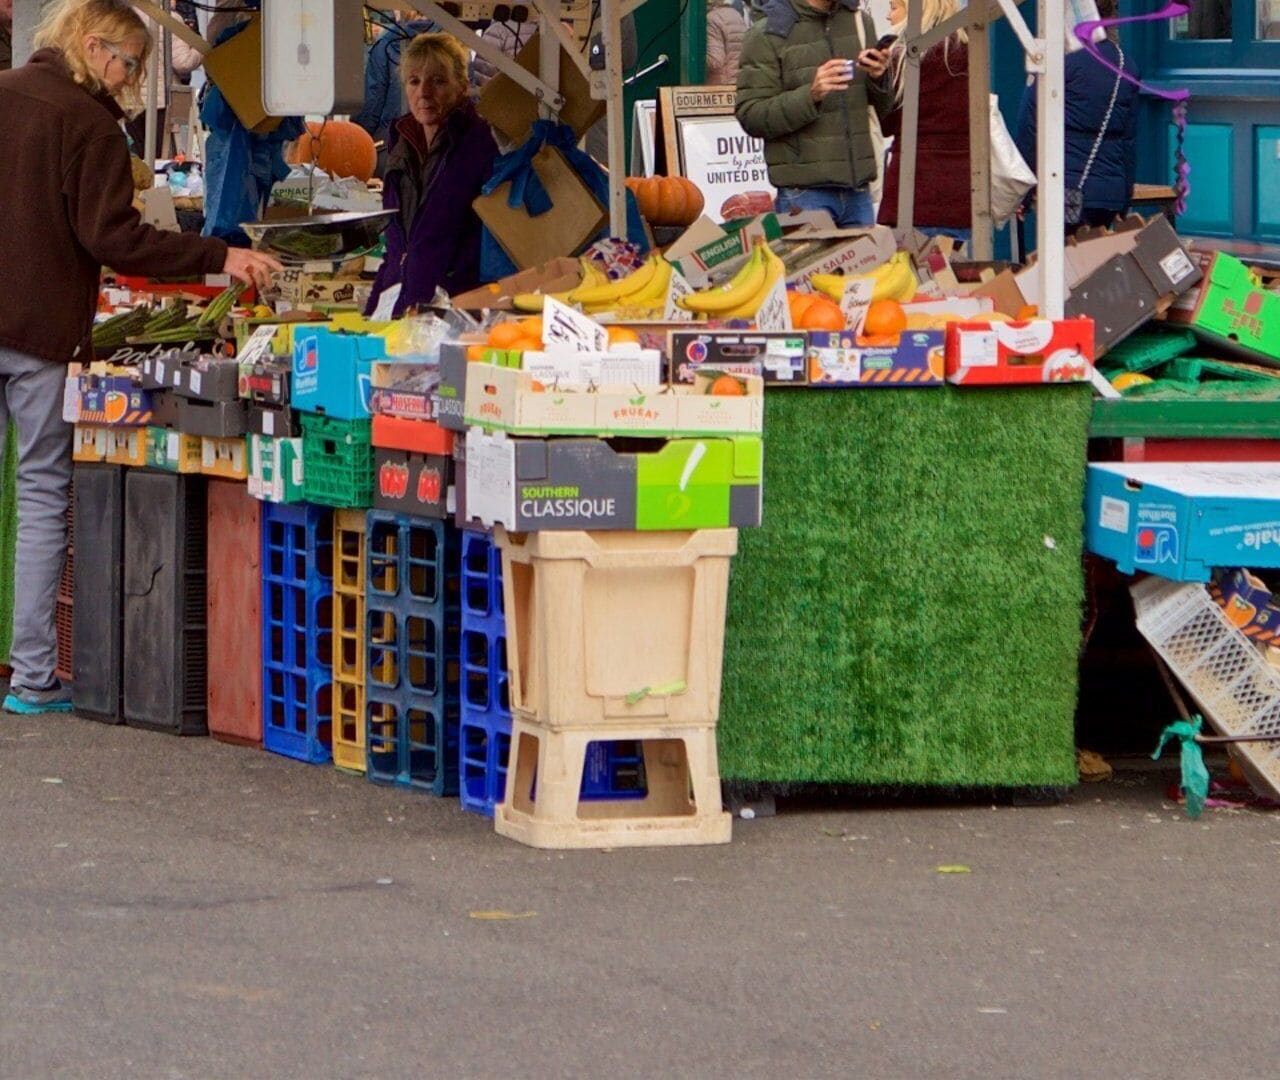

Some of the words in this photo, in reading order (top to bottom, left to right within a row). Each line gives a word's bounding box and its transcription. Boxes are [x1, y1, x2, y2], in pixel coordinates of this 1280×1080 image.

[676, 94, 724, 106] GOURMET
[707, 170, 750, 184] UNITED
[751, 168, 767, 182] BY
[273, 187, 310, 196] SPINAC
[700, 235, 741, 261] ENGLISH
[822, 249, 856, 274] SALAD
[438, 398, 465, 418] CLASSIQ
[522, 485, 580, 499] SOUTHERN
[520, 498, 616, 519] CLASSIQUE
